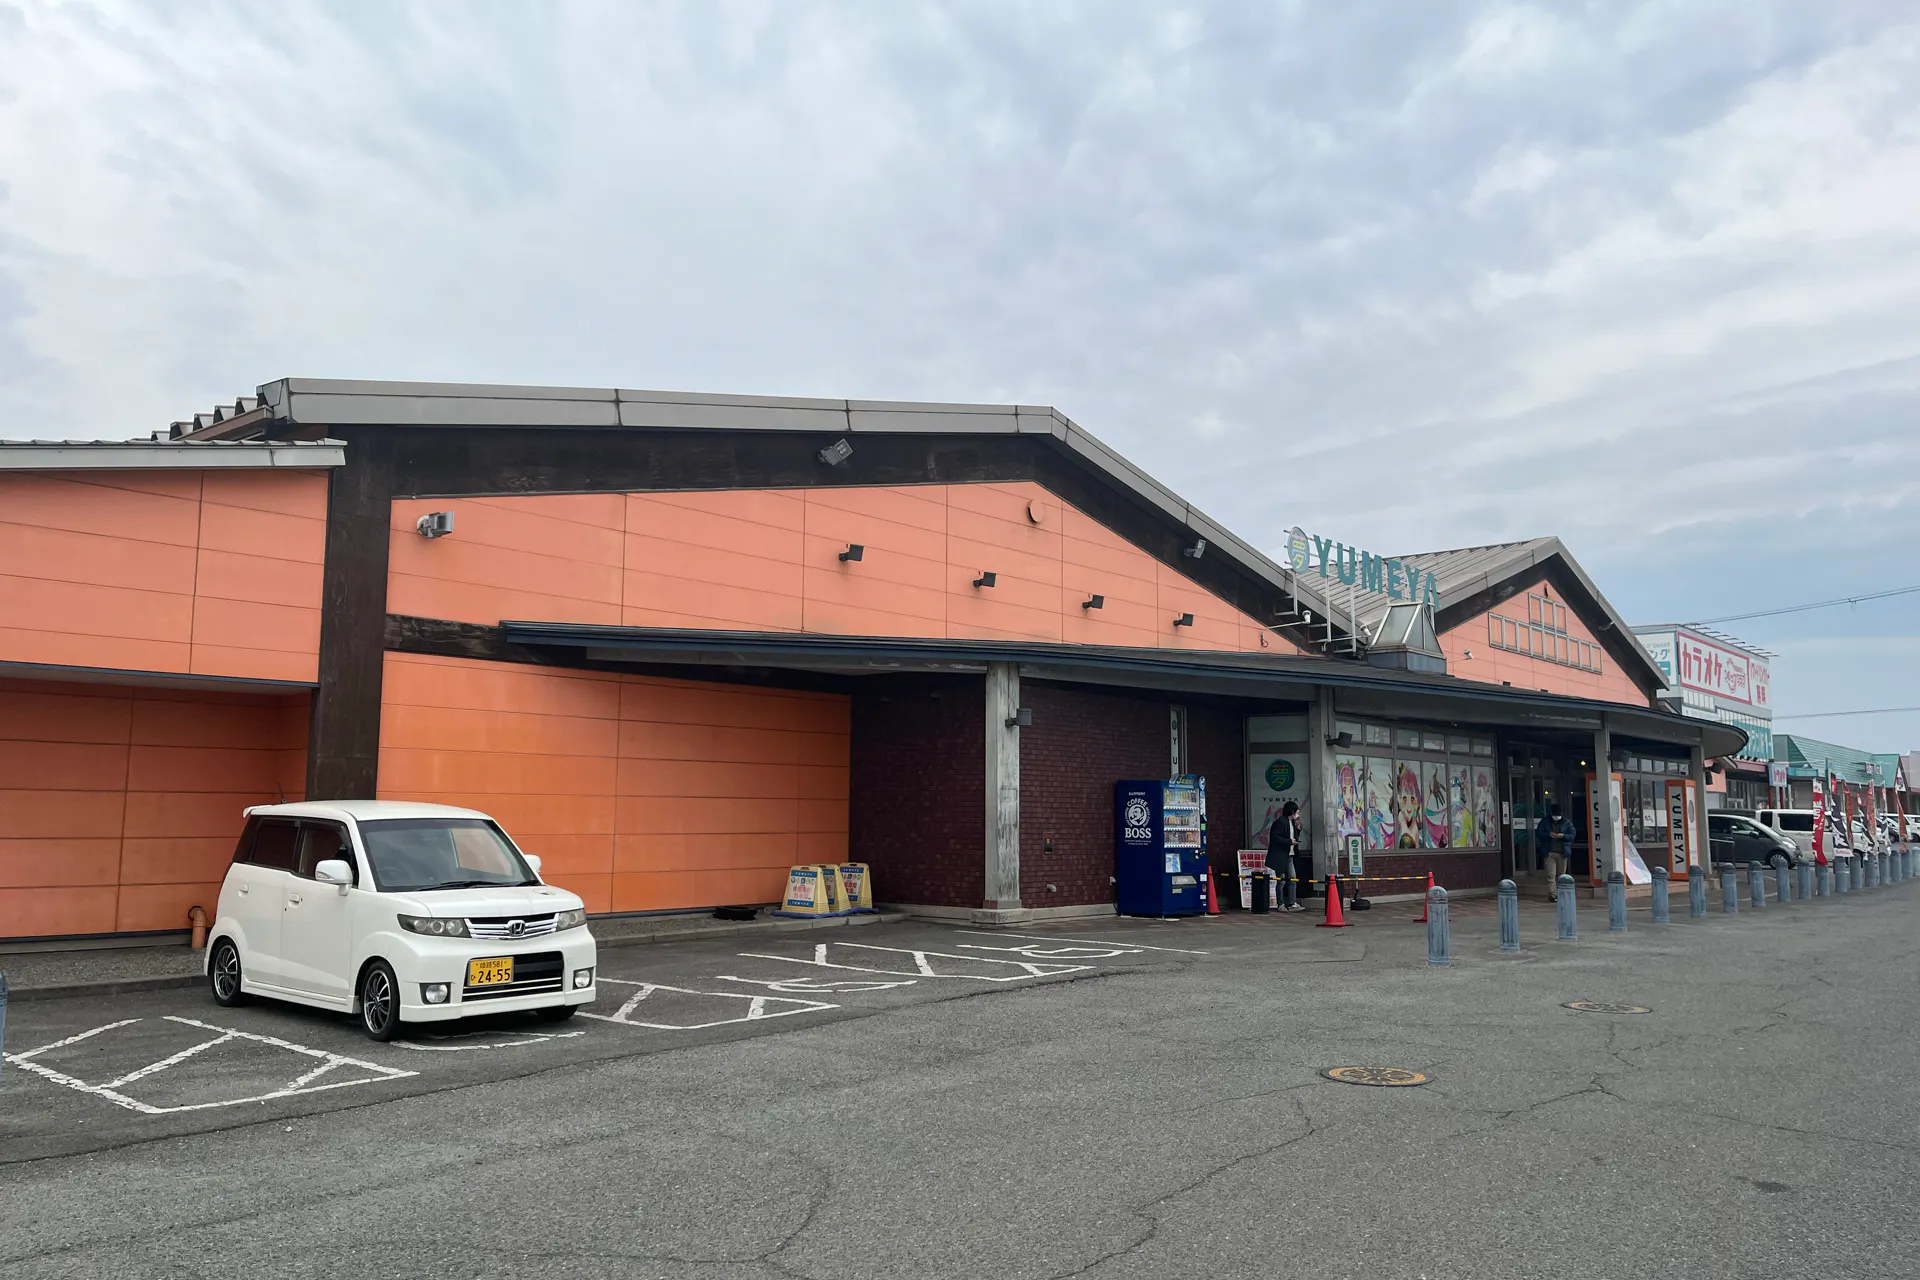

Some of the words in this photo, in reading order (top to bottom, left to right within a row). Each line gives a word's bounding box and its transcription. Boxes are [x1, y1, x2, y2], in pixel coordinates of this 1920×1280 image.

[1313, 534, 1441, 611] YUMEYA
[1682, 642, 1722, 688] カラオケ
[1127, 798, 1148, 807] COFFEE
[1124, 828, 1152, 838] BOSS
[1672, 794, 1684, 864] YUMEYA
[478, 968, 510, 984] 24-55
